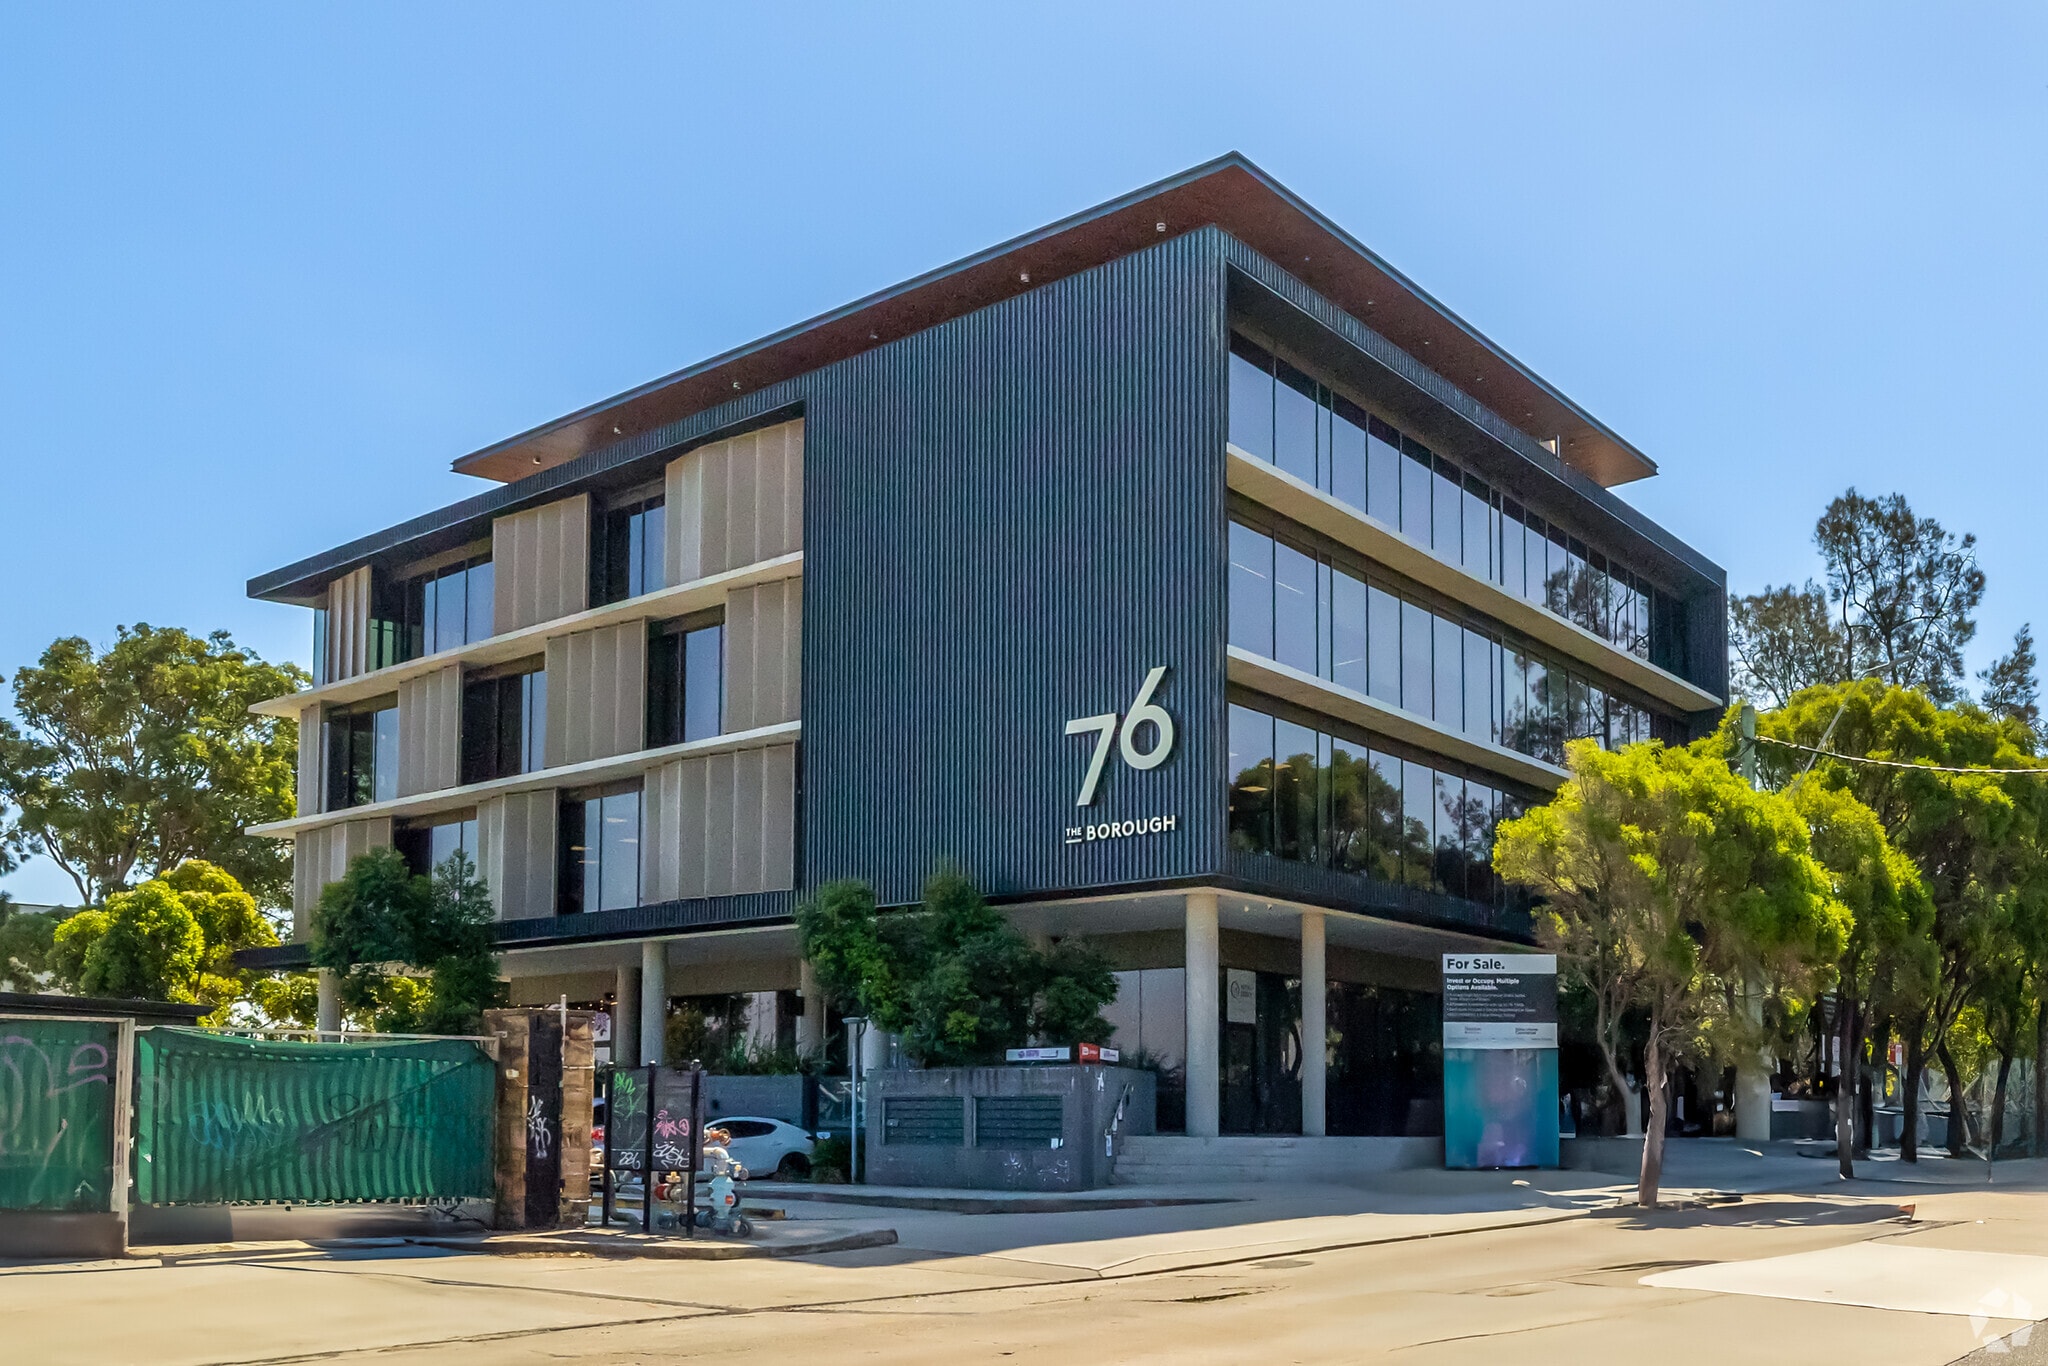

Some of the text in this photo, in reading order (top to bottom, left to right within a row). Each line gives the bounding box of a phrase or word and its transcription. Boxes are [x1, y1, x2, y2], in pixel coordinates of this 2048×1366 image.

[1065, 665, 1174, 806] 76
[1066, 815, 1176, 841] THE BOROUGH
[1447, 959, 1505, 969] For Sale.
